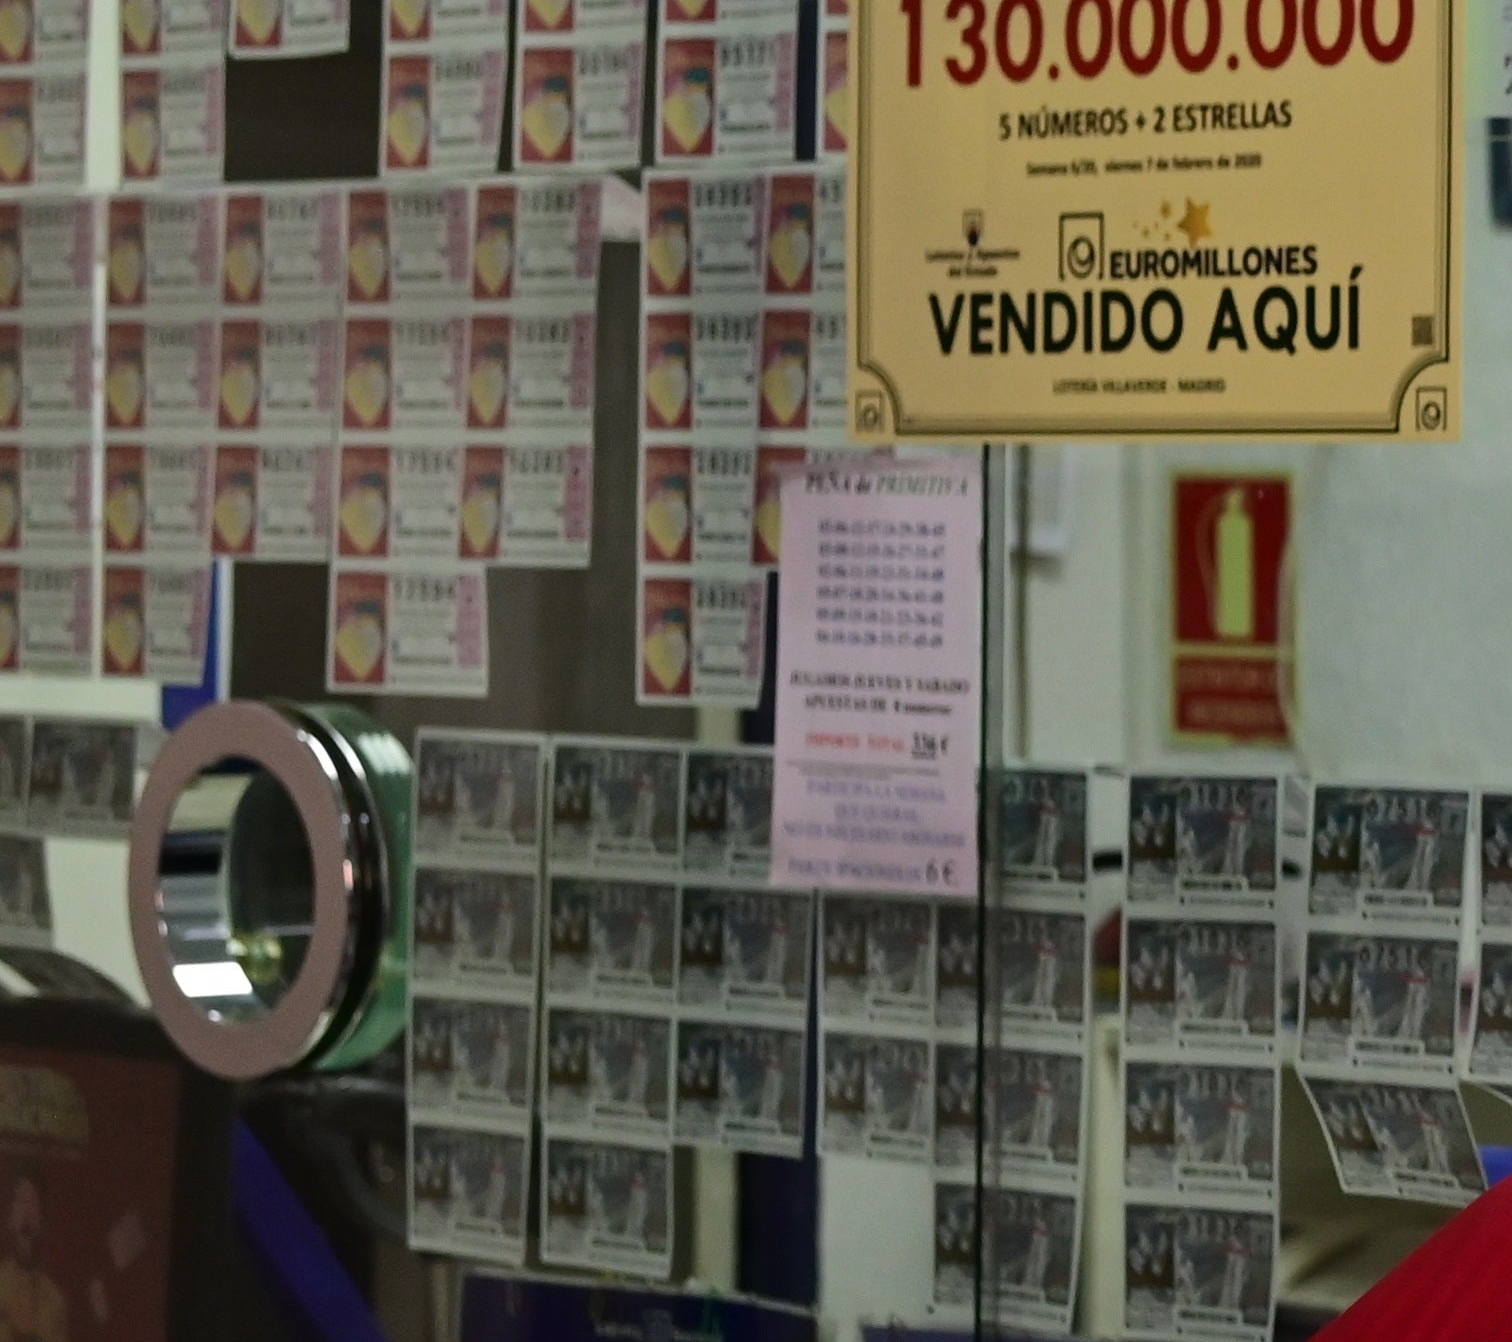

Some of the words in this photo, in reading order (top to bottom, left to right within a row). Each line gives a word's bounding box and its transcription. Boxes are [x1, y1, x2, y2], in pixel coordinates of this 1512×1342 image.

[999, 114, 1011, 141] 5
[1018, 105, 1128, 140] NÚMEROS
[1153, 105, 1167, 131] 2
[1172, 100, 1293, 131] ESTRELLAS
[1110, 245, 1318, 280] EUROMILLONES
[929, 287, 1184, 356] VENDIDO
[1207, 265, 1363, 357] AQUÍ
